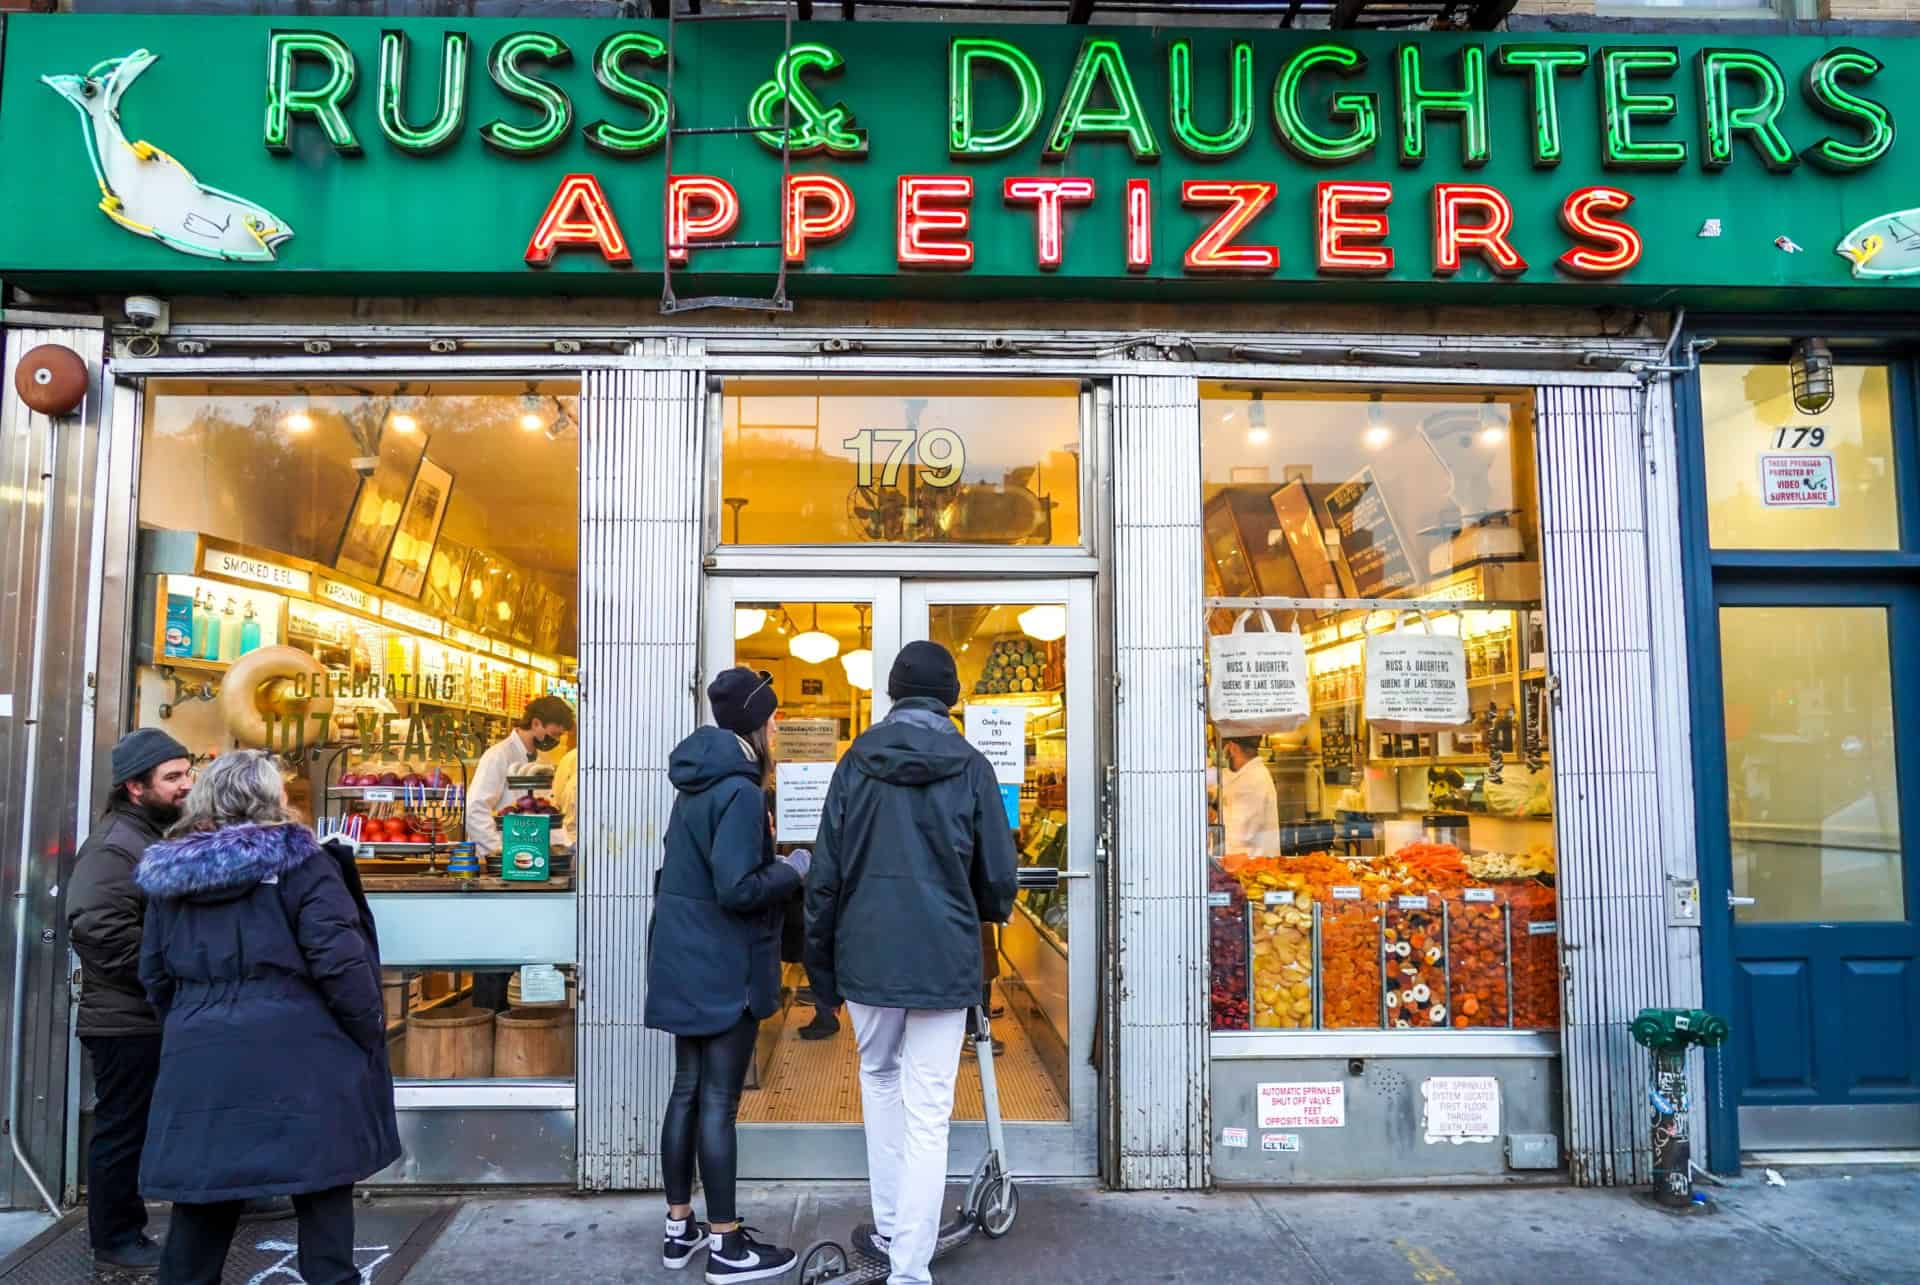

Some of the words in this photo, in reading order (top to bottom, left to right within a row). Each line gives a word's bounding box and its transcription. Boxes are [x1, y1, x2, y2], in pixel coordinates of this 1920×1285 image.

[263, 28, 677, 158] RUSS
[747, 43, 869, 160] &
[947, 34, 1896, 172] DAUGHTERS
[525, 172, 1643, 277] APPETIZERS
[1776, 427, 1825, 448] 179
[842, 427, 966, 489] 179
[1776, 479, 1800, 489] VIDEO
[1769, 491, 1828, 502] SURVEILLANCE
[223, 556, 269, 579] SMOKED
[1385, 659, 1403, 672] RUSS
[294, 672, 455, 700] CELEBRATING
[981, 719, 998, 727] Only
[356, 711, 482, 763] YEARS
[1262, 1087, 1301, 1096] AUTOMATIC
[1303, 1086, 1341, 1096] SPRINKLER
[1271, 1097, 1290, 1106] SHUT
[1293, 1097, 1307, 1105] OFF
[1308, 1096, 1331, 1105] VALVE
[1303, 1106, 1322, 1115] FEET
[1264, 1117, 1302, 1126] OPPOSITE
[1303, 1116, 1320, 1125] THIS
[1321, 1116, 1339, 1125] SIGN
